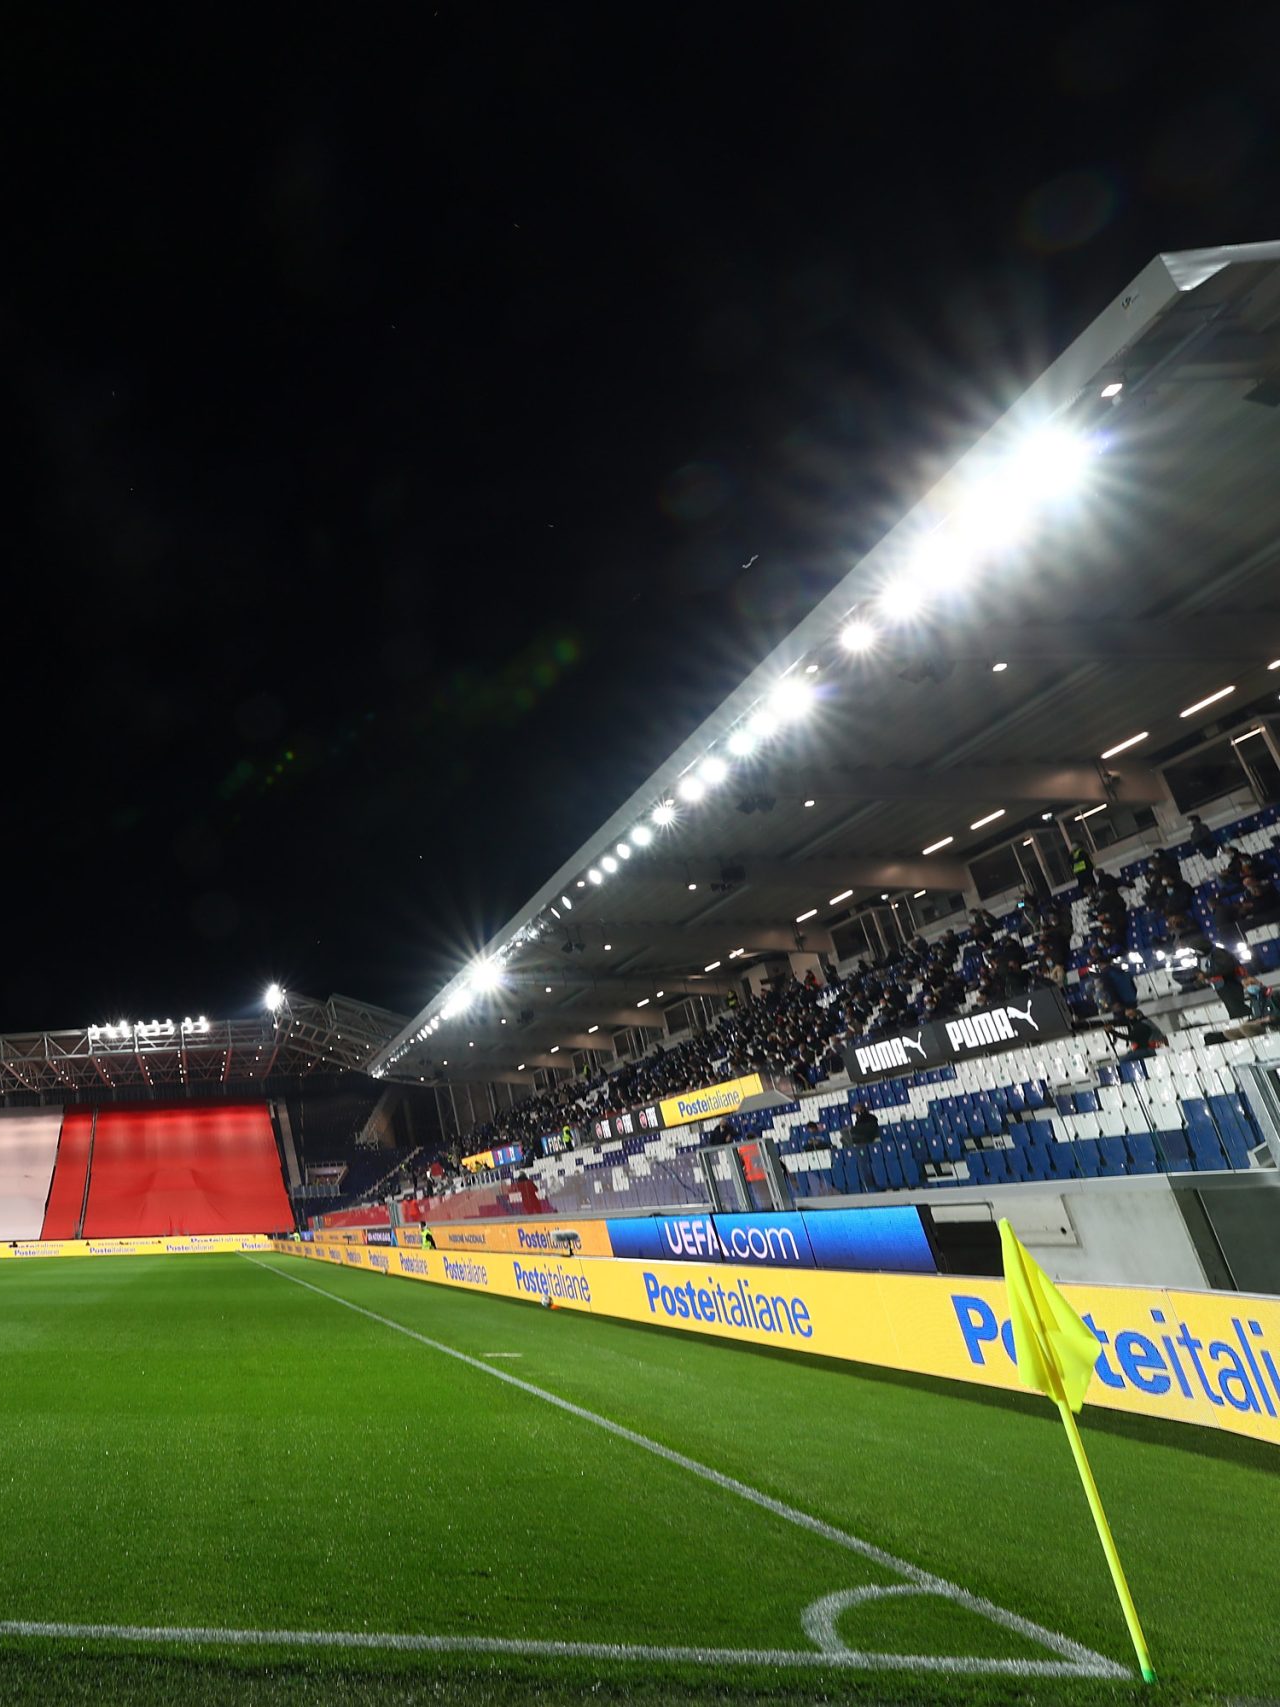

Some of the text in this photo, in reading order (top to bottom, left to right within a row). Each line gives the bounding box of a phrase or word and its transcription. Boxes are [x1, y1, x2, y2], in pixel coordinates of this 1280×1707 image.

[664, 1220, 799, 1260] UEFA.com
[513, 1261, 591, 1302] Posteitaliane
[643, 1271, 813, 1338] Posteitaliane
